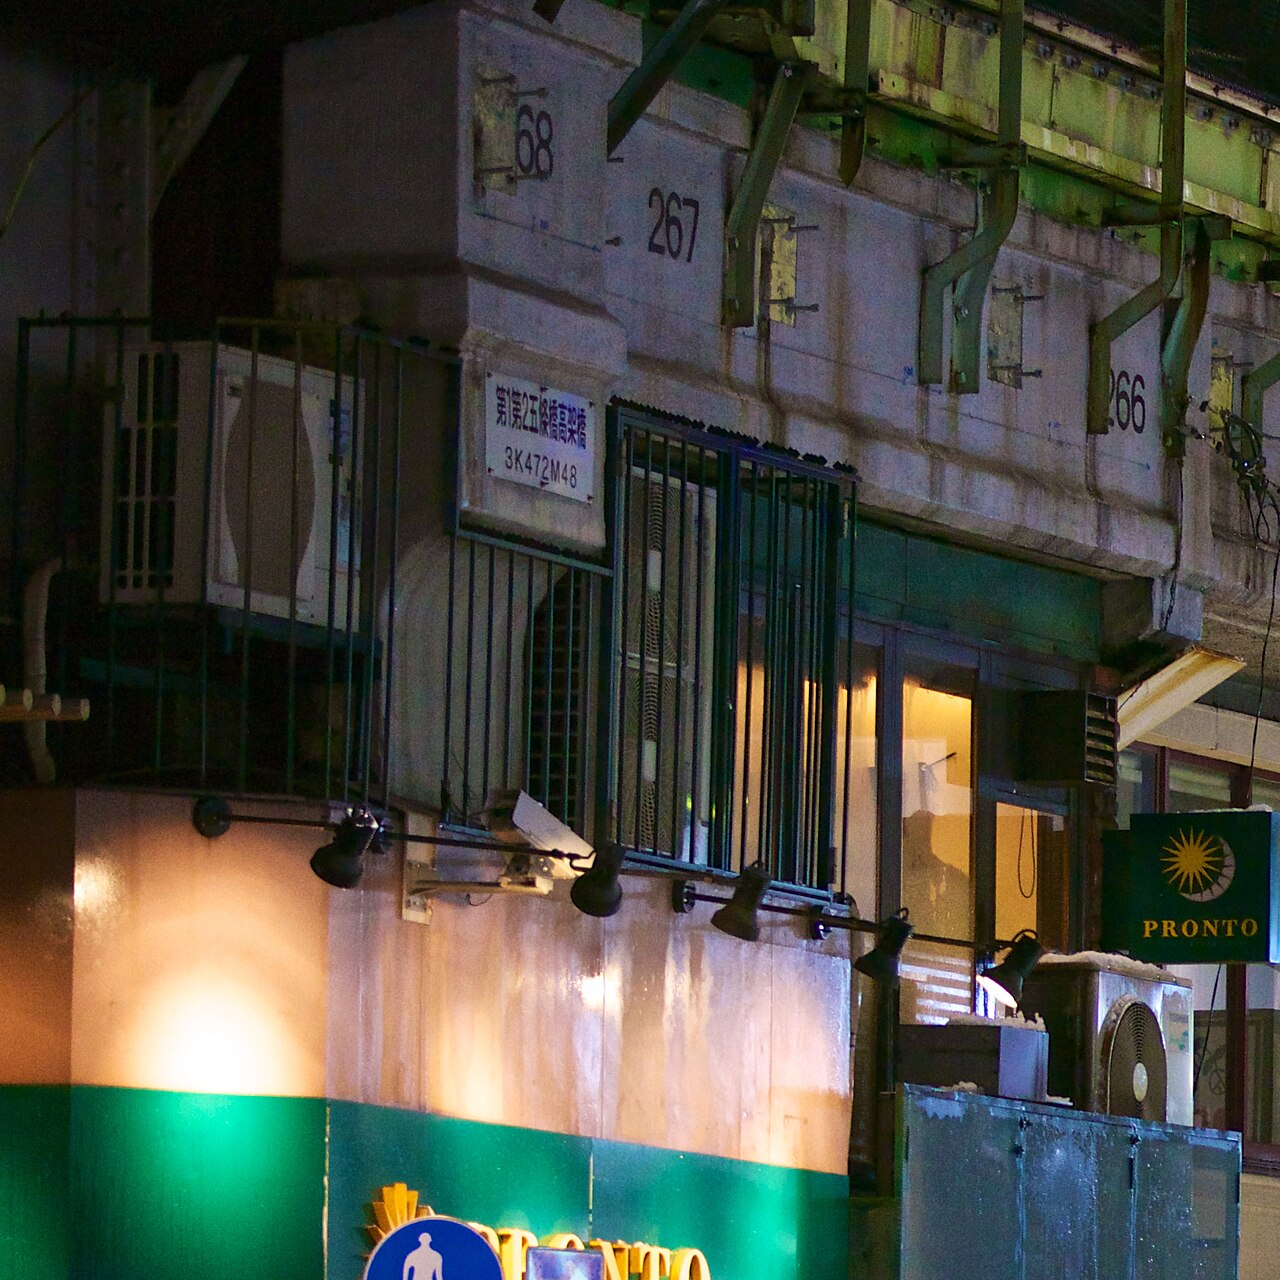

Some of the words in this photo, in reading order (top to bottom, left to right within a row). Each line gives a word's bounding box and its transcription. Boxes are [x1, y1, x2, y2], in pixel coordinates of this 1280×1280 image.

[648, 187, 699, 263] 267
[505, 446, 577, 488] 3K472M48
[1143, 919, 1259, 938] PRONTO
